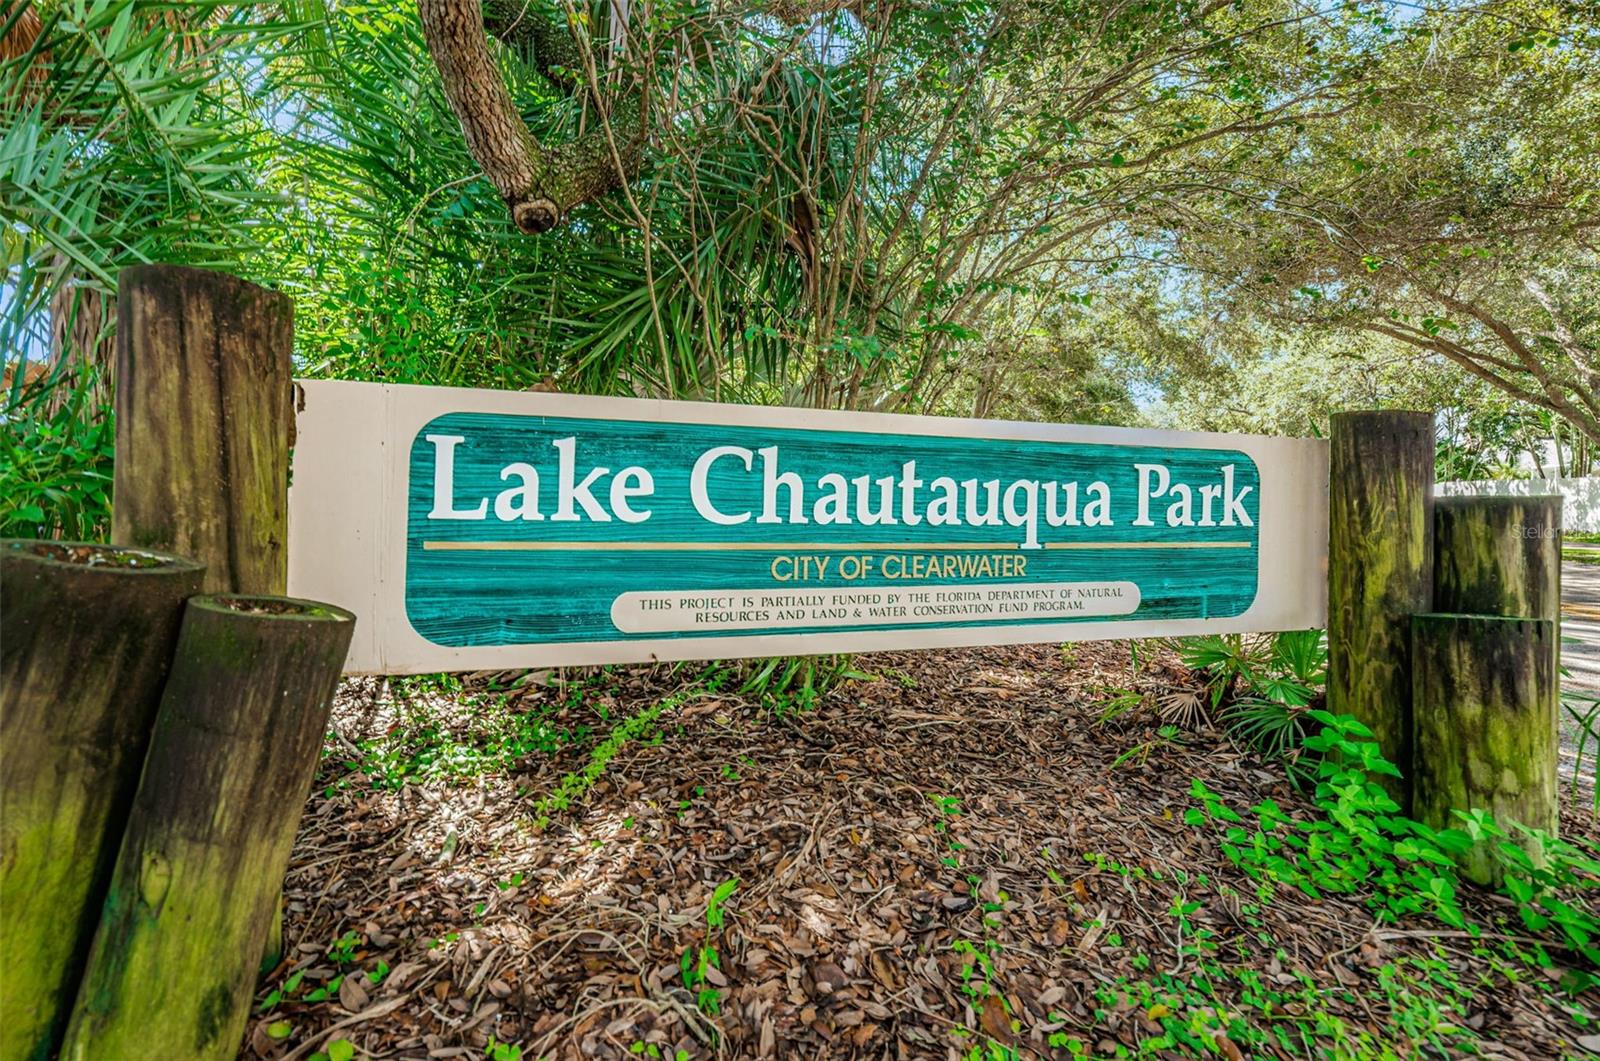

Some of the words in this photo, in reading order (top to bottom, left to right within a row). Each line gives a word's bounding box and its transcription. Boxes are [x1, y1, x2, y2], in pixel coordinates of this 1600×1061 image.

[425, 434, 655, 523] Lake
[690, 445, 1112, 549] Chautauqua
[1132, 463, 1254, 527] Park
[770, 556, 830, 581] CITY
[839, 555, 873, 580] OF
[881, 554, 1027, 579] CLEARWATER
[640, 599, 672, 610] THIS
[680, 597, 735, 610] PROJECT
[742, 597, 754, 607] IS
[761, 595, 825, 607] PARTIALLY
[832, 594, 881, 605] FUNDED
[887, 594, 901, 604] BY
[909, 593, 930, 603] THE
[936, 591, 982, 602] FLORIDA
[988, 589, 1054, 601] DEPARTMENT
[1060, 589, 1073, 598] OF
[1078, 588, 1123, 598] NATURAL
[695, 610, 770, 623] RESOURCES
[776, 609, 805, 620] AND
[812, 608, 847, 619] LAND
[852, 608, 862, 618] &
[869, 607, 907, 617] WATER
[913, 603, 994, 616] CONSERVATION
[999, 602, 1029, 613] FUND
[1033, 600, 1085, 612] PROGRAM.
